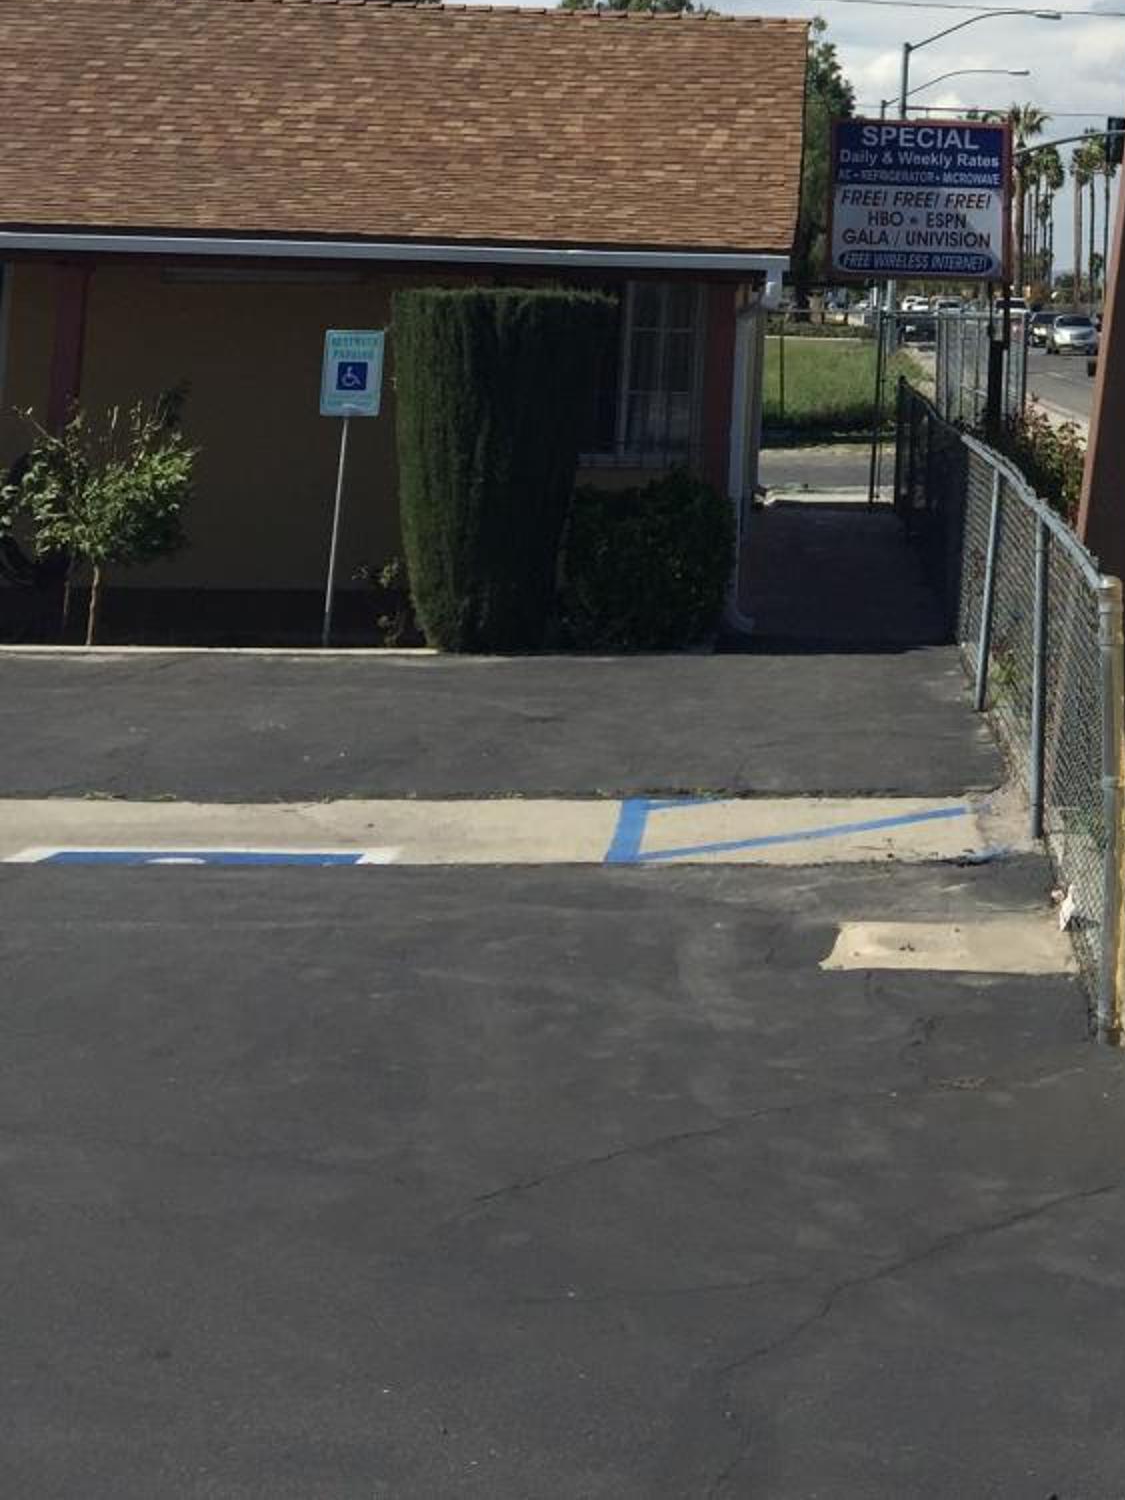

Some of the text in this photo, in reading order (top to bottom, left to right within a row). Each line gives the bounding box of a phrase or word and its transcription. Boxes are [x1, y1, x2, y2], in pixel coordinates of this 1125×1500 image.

[862, 125, 979, 149] SPECIAL
[839, 149, 1000, 169] Daily & Weekly Rates
[841, 189, 992, 210] FREE! FREE! FREE!
[867, 210, 968, 229] HBO ESPN
[841, 228, 889, 246] GALA
[905, 230, 992, 249] UNIVISION
